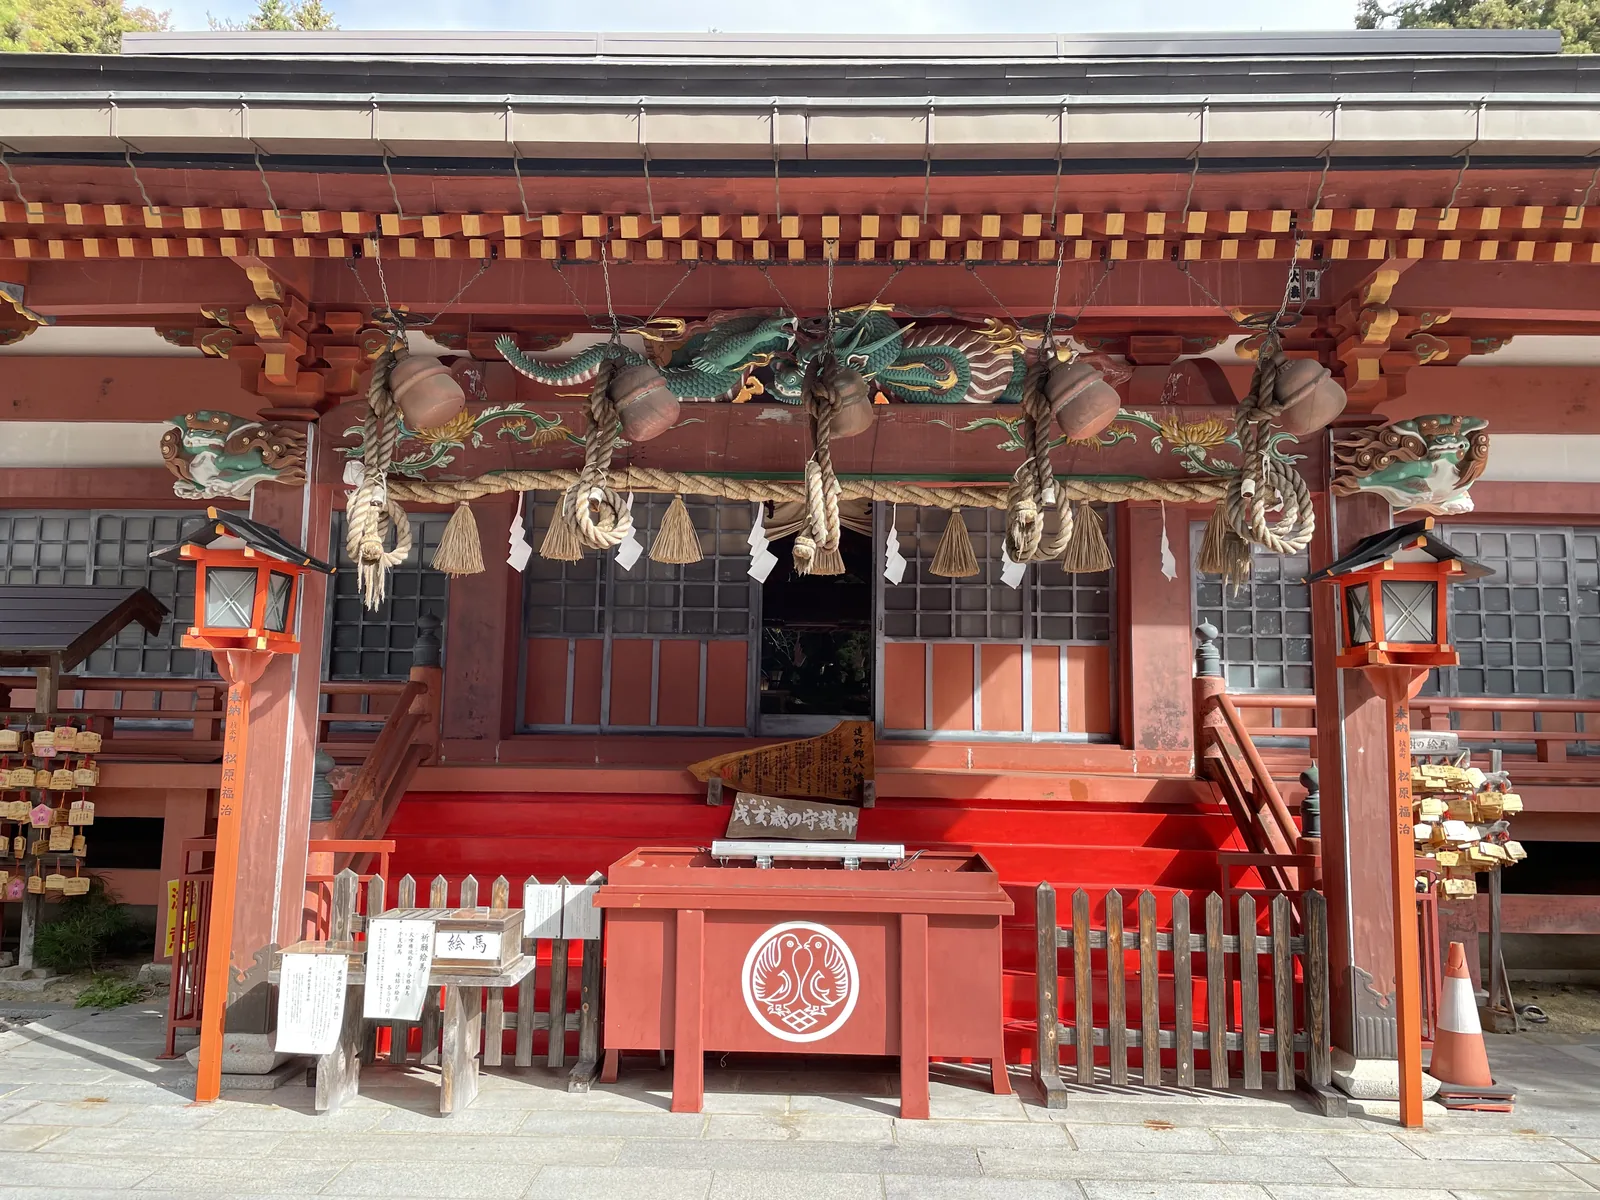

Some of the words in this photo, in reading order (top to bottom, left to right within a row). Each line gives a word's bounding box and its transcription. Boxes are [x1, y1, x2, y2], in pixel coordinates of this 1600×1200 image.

[228, 689, 241, 716] 奉納
[1395, 706, 1408, 733] 奉納
[220, 752, 237, 816] 松原福治
[842, 756, 852, 798] 五柱の神
[733, 804, 858, 835] 戌亥歳の守護神
[1398, 770, 1411, 835] 松原福治
[418, 933, 430, 973] 祈願絵馬
[447, 934, 486, 954] 絵馬
